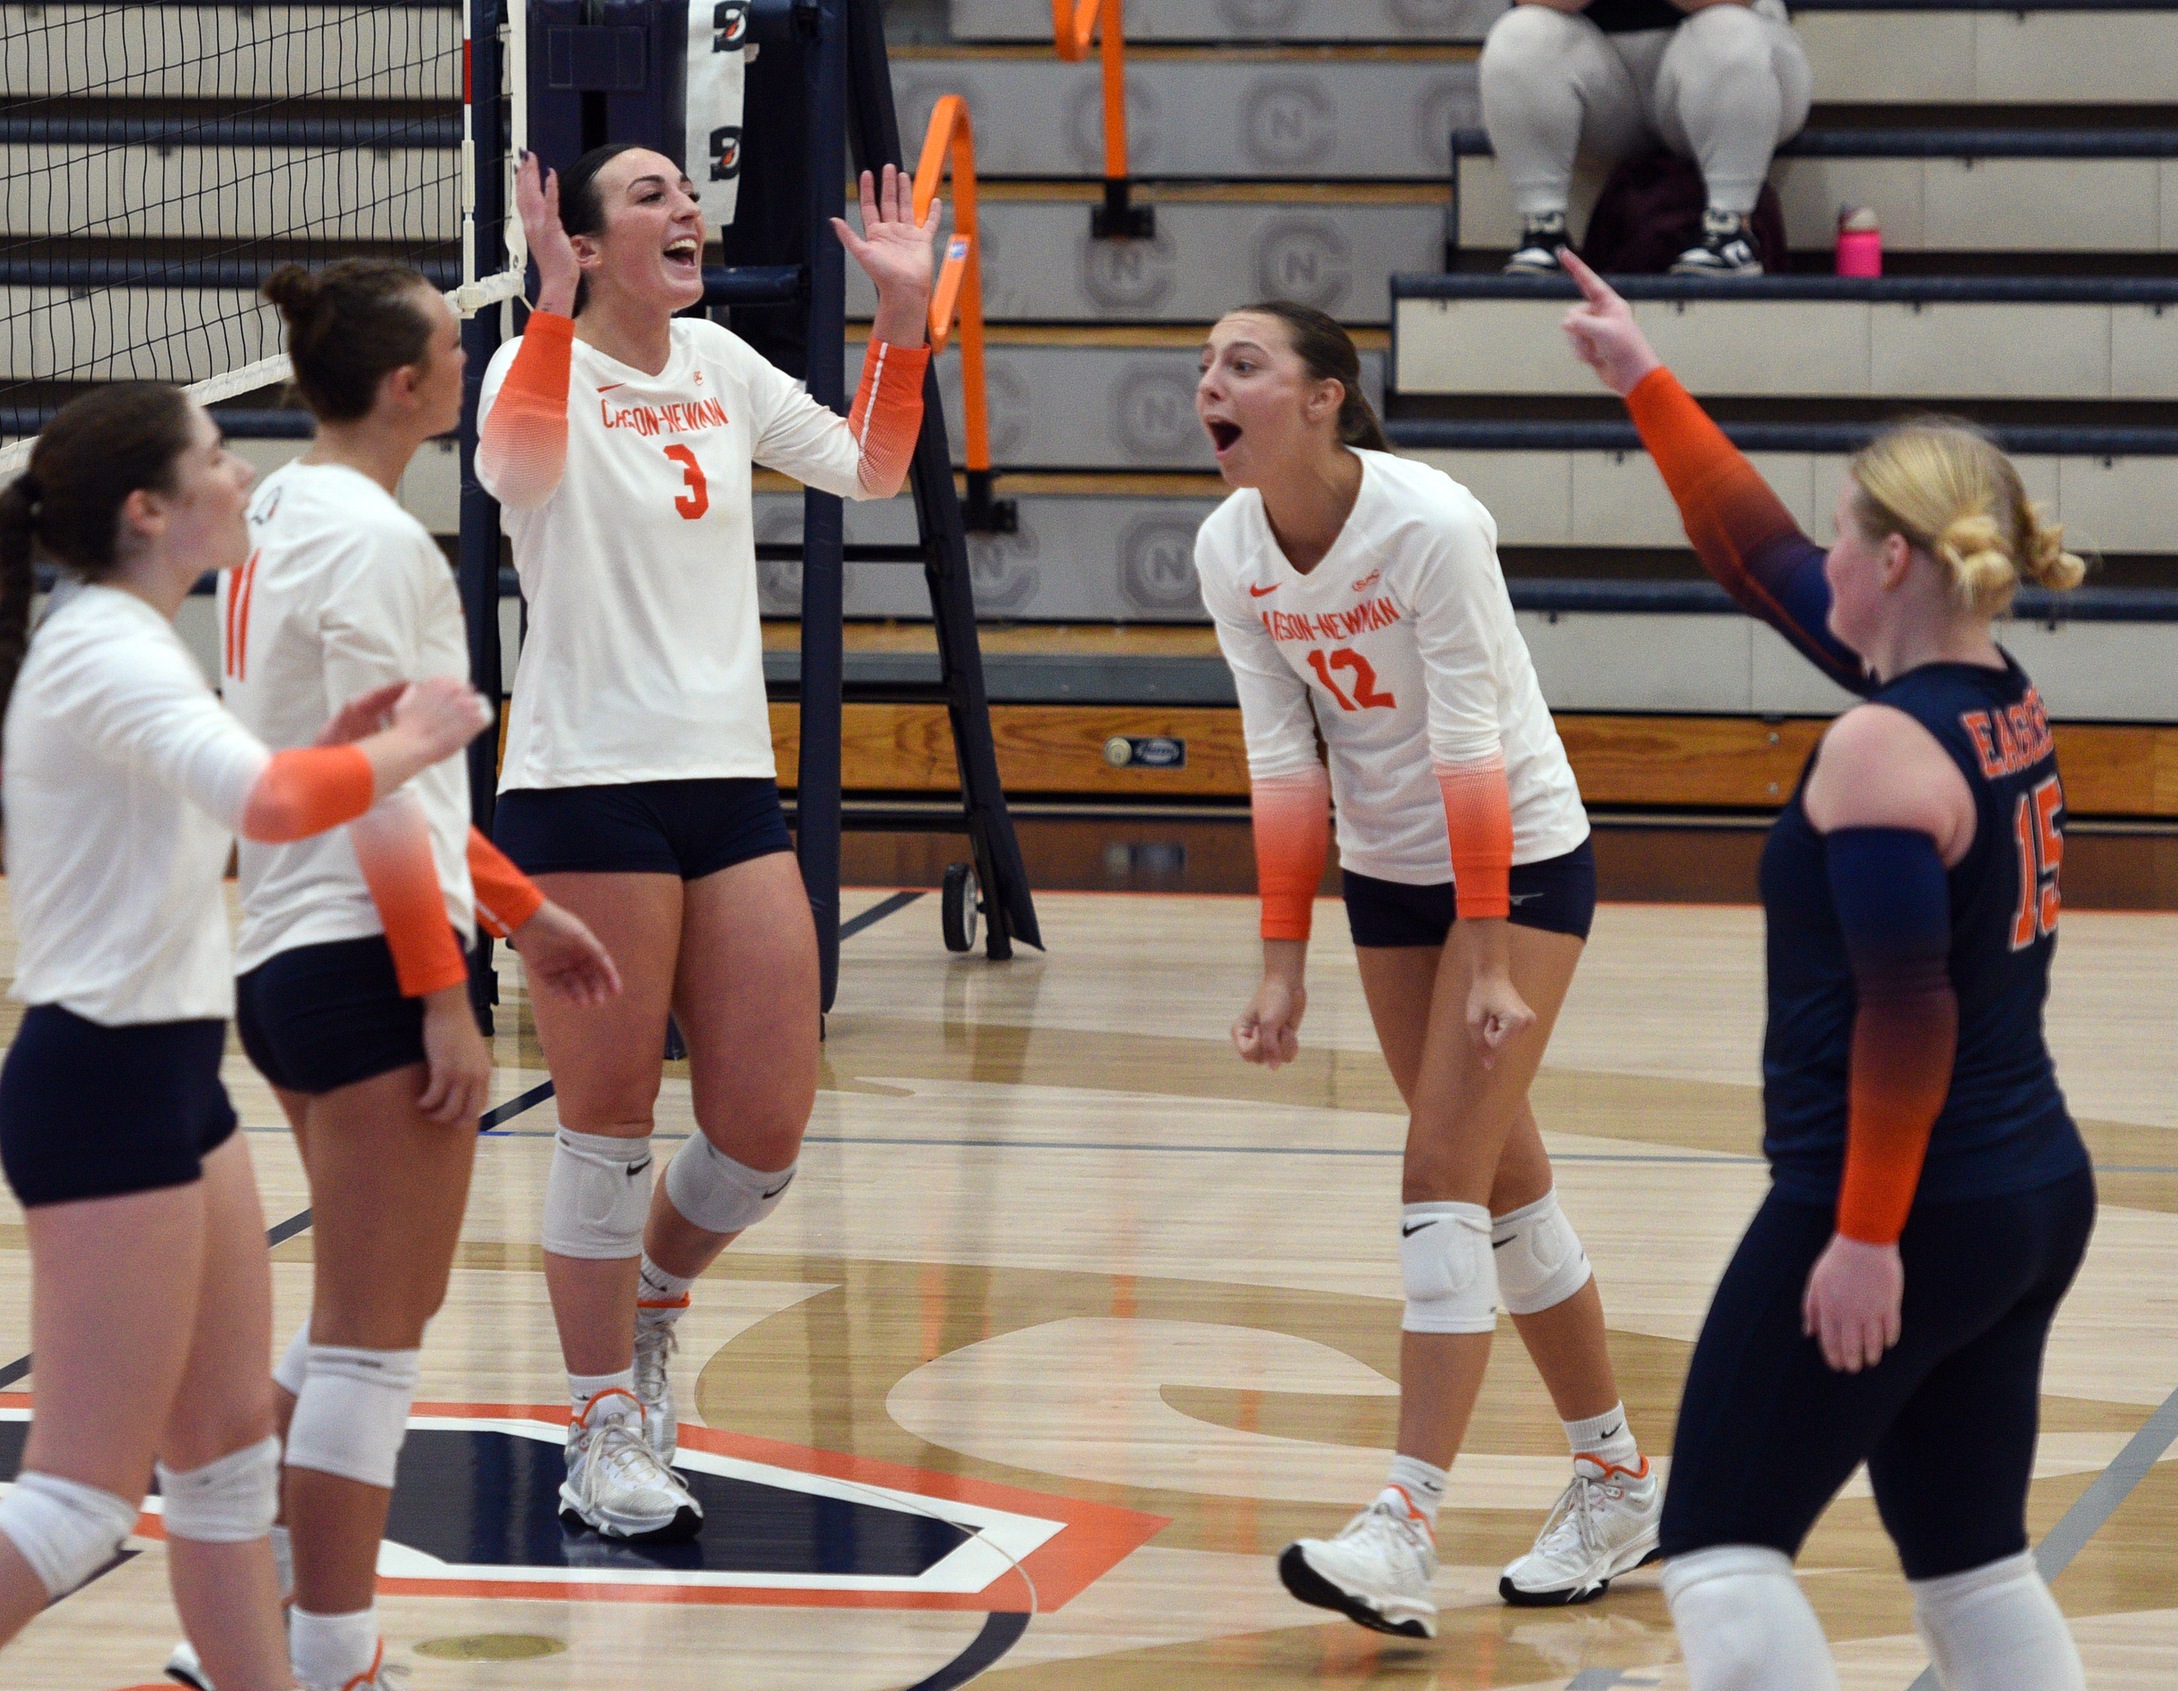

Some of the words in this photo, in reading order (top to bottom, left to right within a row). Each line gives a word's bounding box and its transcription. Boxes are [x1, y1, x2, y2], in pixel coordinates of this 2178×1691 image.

[663, 443, 710, 520] 3
[1307, 647, 1397, 712] 12
[2010, 774, 2065, 951] 15
